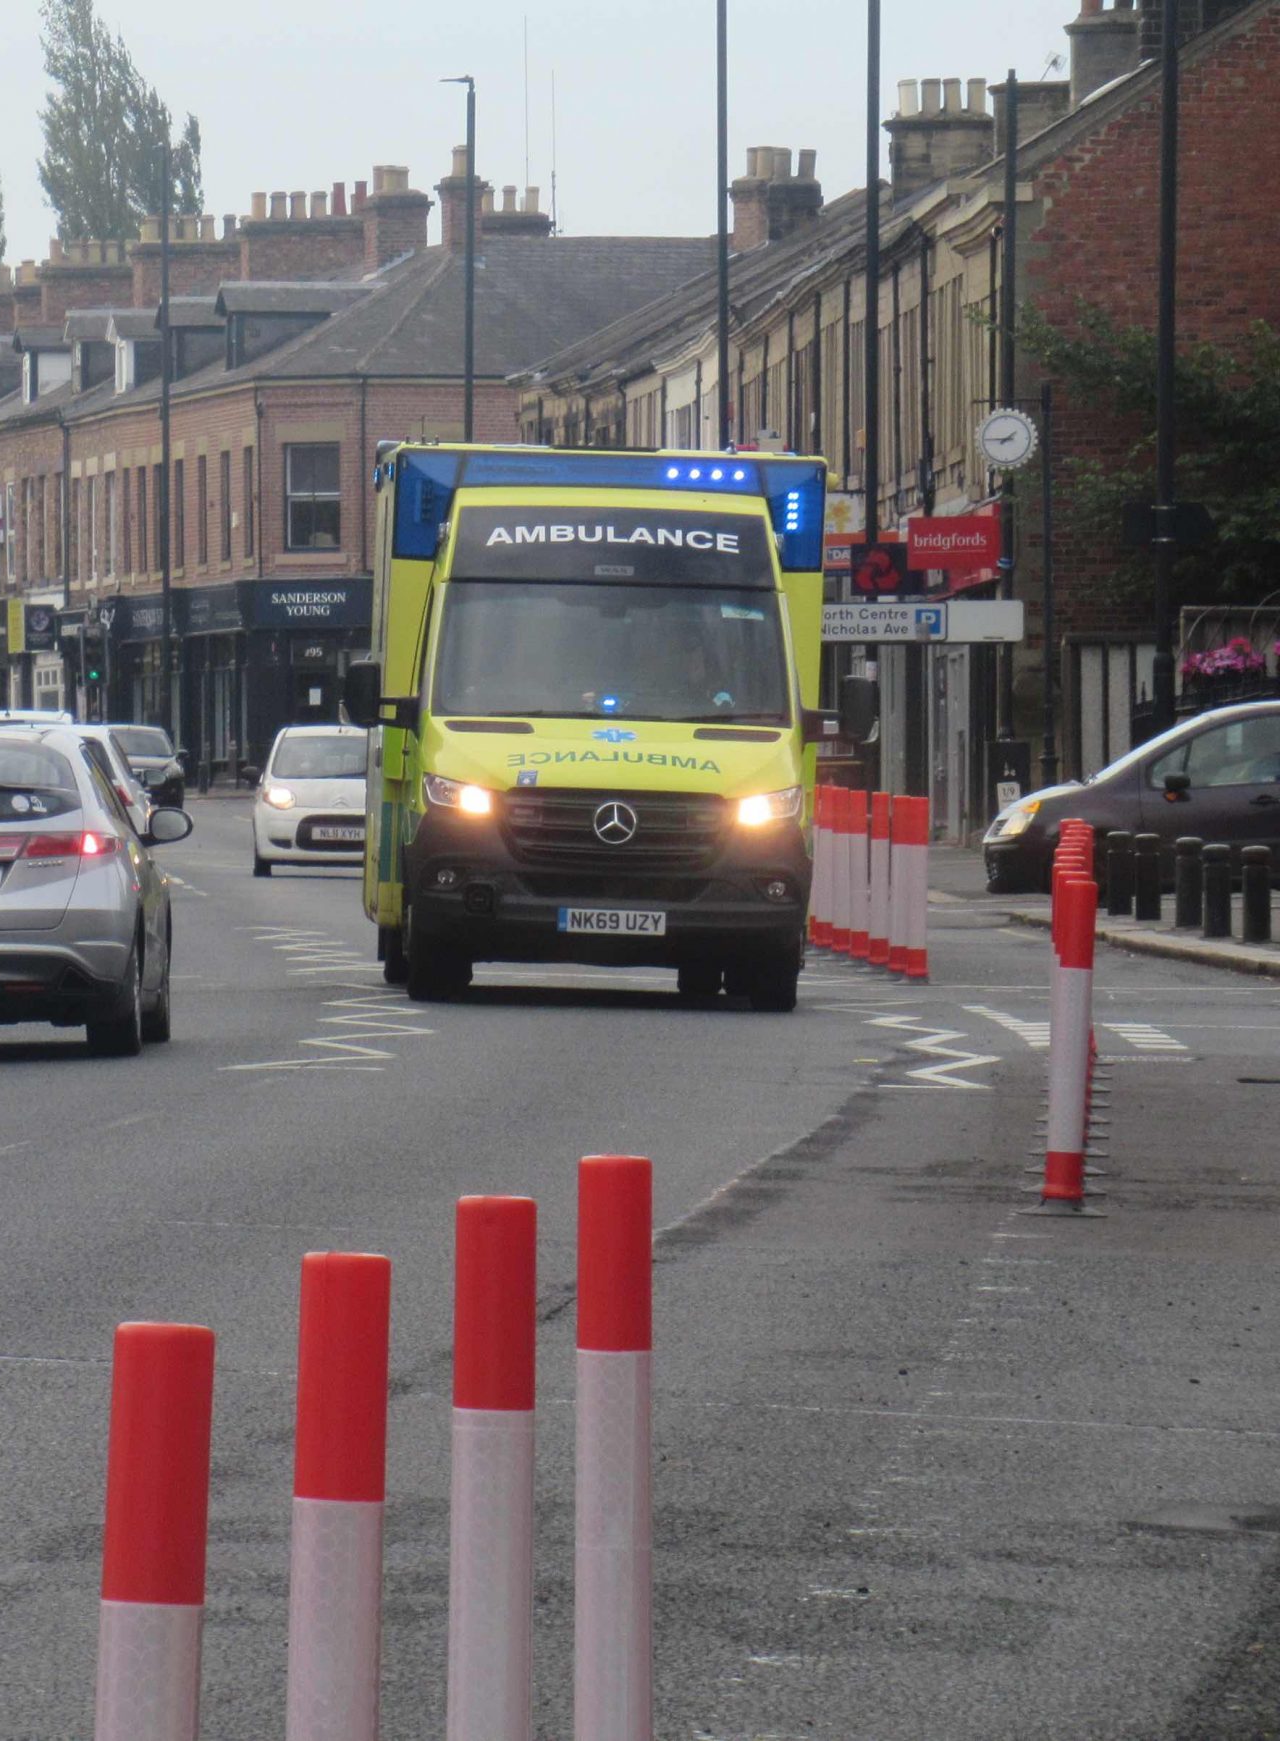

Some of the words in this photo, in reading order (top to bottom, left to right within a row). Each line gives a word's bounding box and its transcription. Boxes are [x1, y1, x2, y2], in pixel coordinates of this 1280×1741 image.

[486, 525, 740, 554] AMBULANCE
[913, 532, 988, 551] bridgfords
[271, 592, 347, 605] SANDERSON
[286, 605, 331, 617] YOUNG
[859, 608, 909, 621] Centre
[883, 623, 909, 635] Ave
[570, 911, 620, 930] NK69
[625, 914, 662, 932] UZY
